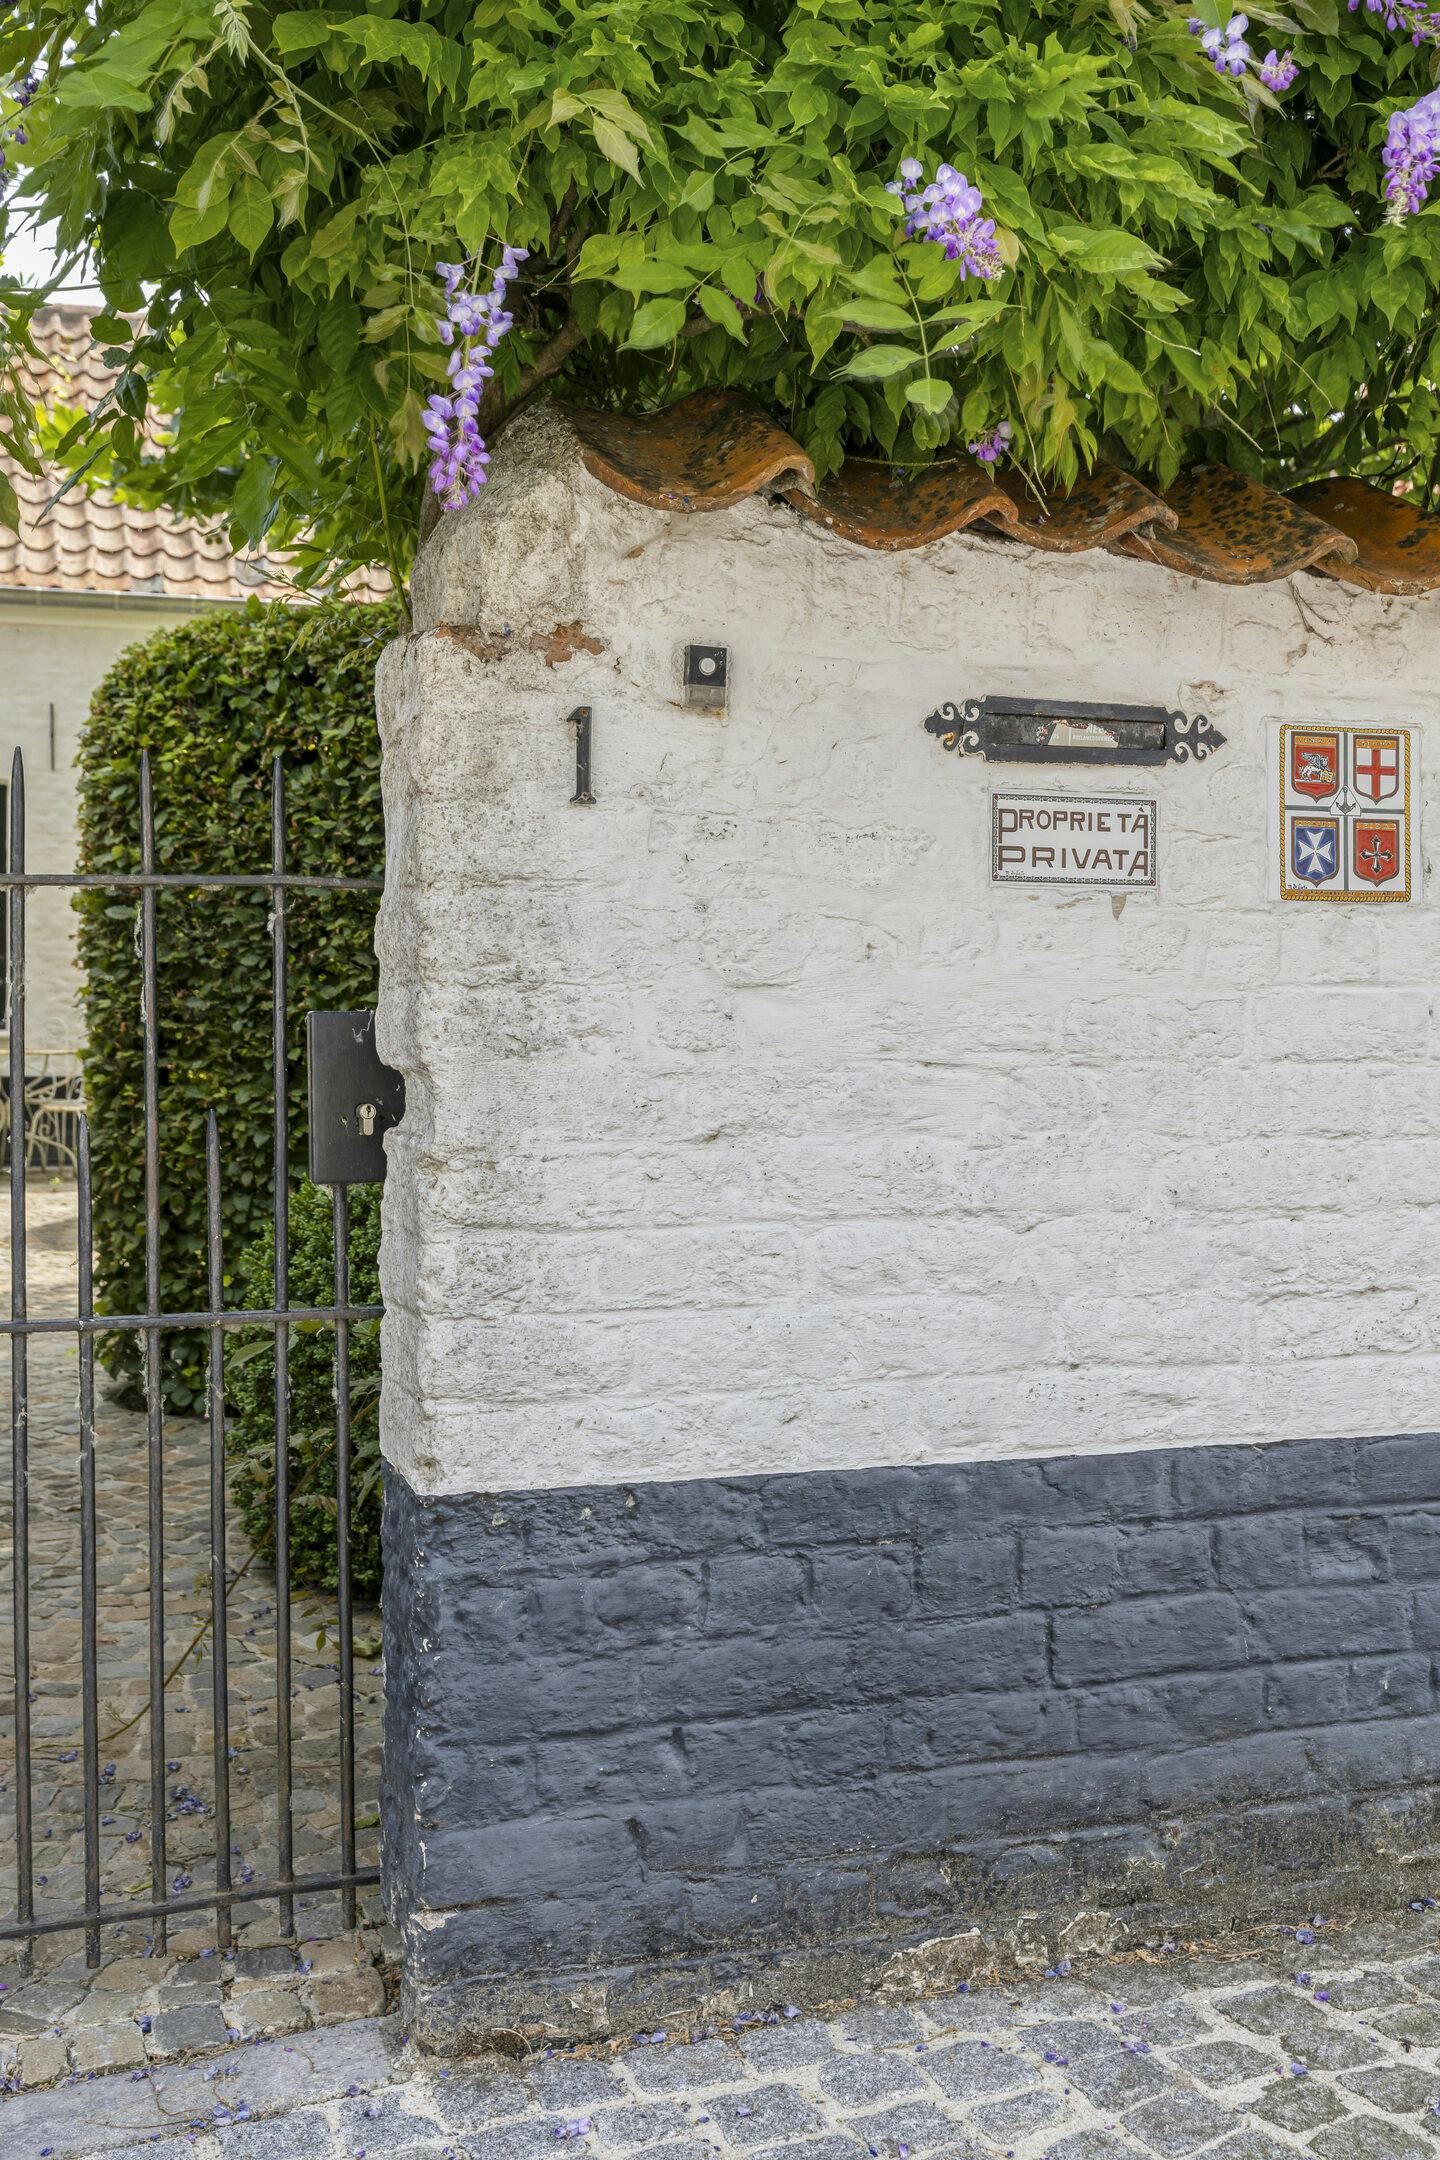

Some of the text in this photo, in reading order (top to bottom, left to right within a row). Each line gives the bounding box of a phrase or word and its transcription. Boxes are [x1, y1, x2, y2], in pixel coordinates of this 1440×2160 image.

[567, 706, 597, 804] 1
[998, 807, 1149, 849] PROPRIETÀ
[998, 846, 1148, 877] PRIVATA
